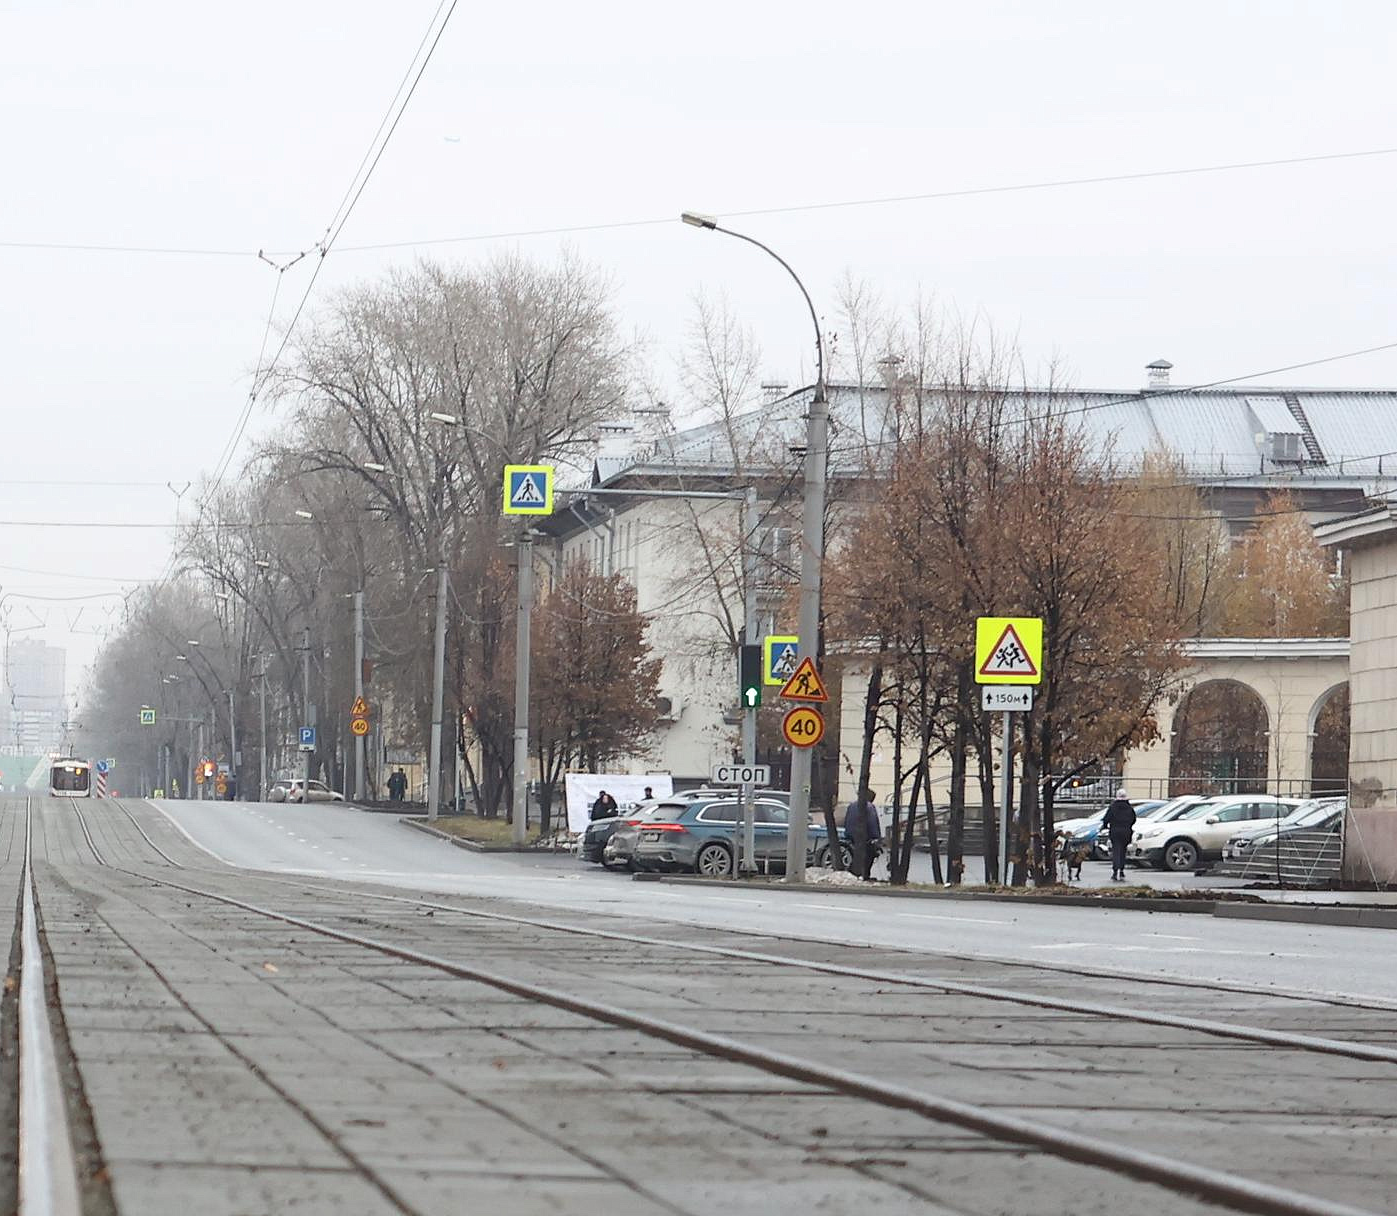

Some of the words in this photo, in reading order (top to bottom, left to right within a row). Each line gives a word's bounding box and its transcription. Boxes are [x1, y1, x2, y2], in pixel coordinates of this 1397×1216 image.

[791, 719, 816, 736] 40
[303, 730, 311, 741] P
[718, 767, 765, 782] СТОП
